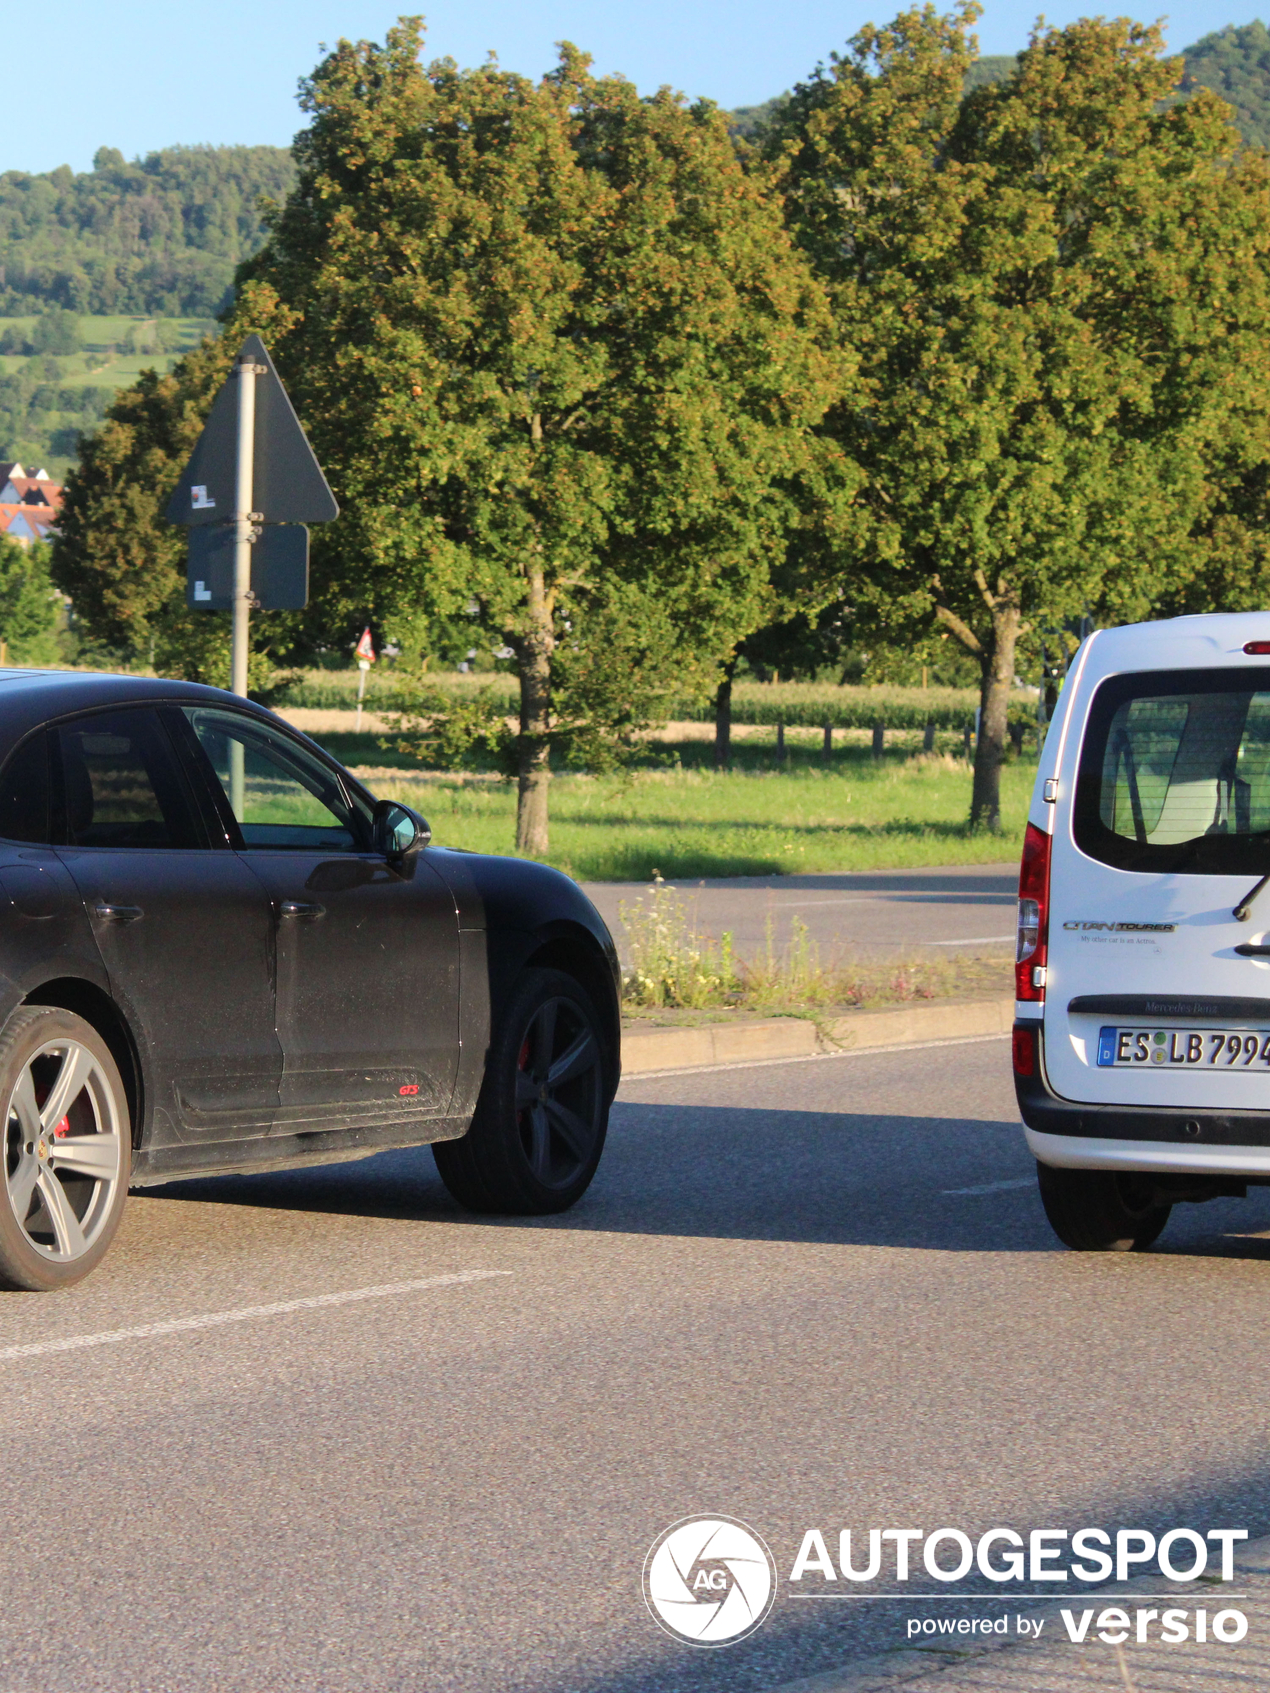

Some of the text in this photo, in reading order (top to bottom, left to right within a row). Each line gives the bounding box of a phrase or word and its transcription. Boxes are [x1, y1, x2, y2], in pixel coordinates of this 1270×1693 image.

[1063, 922, 1173, 931] CITAN TOURER
[1103, 1032, 1270, 1067] D ES LB 7994
[399, 1084, 420, 1095] GTS
